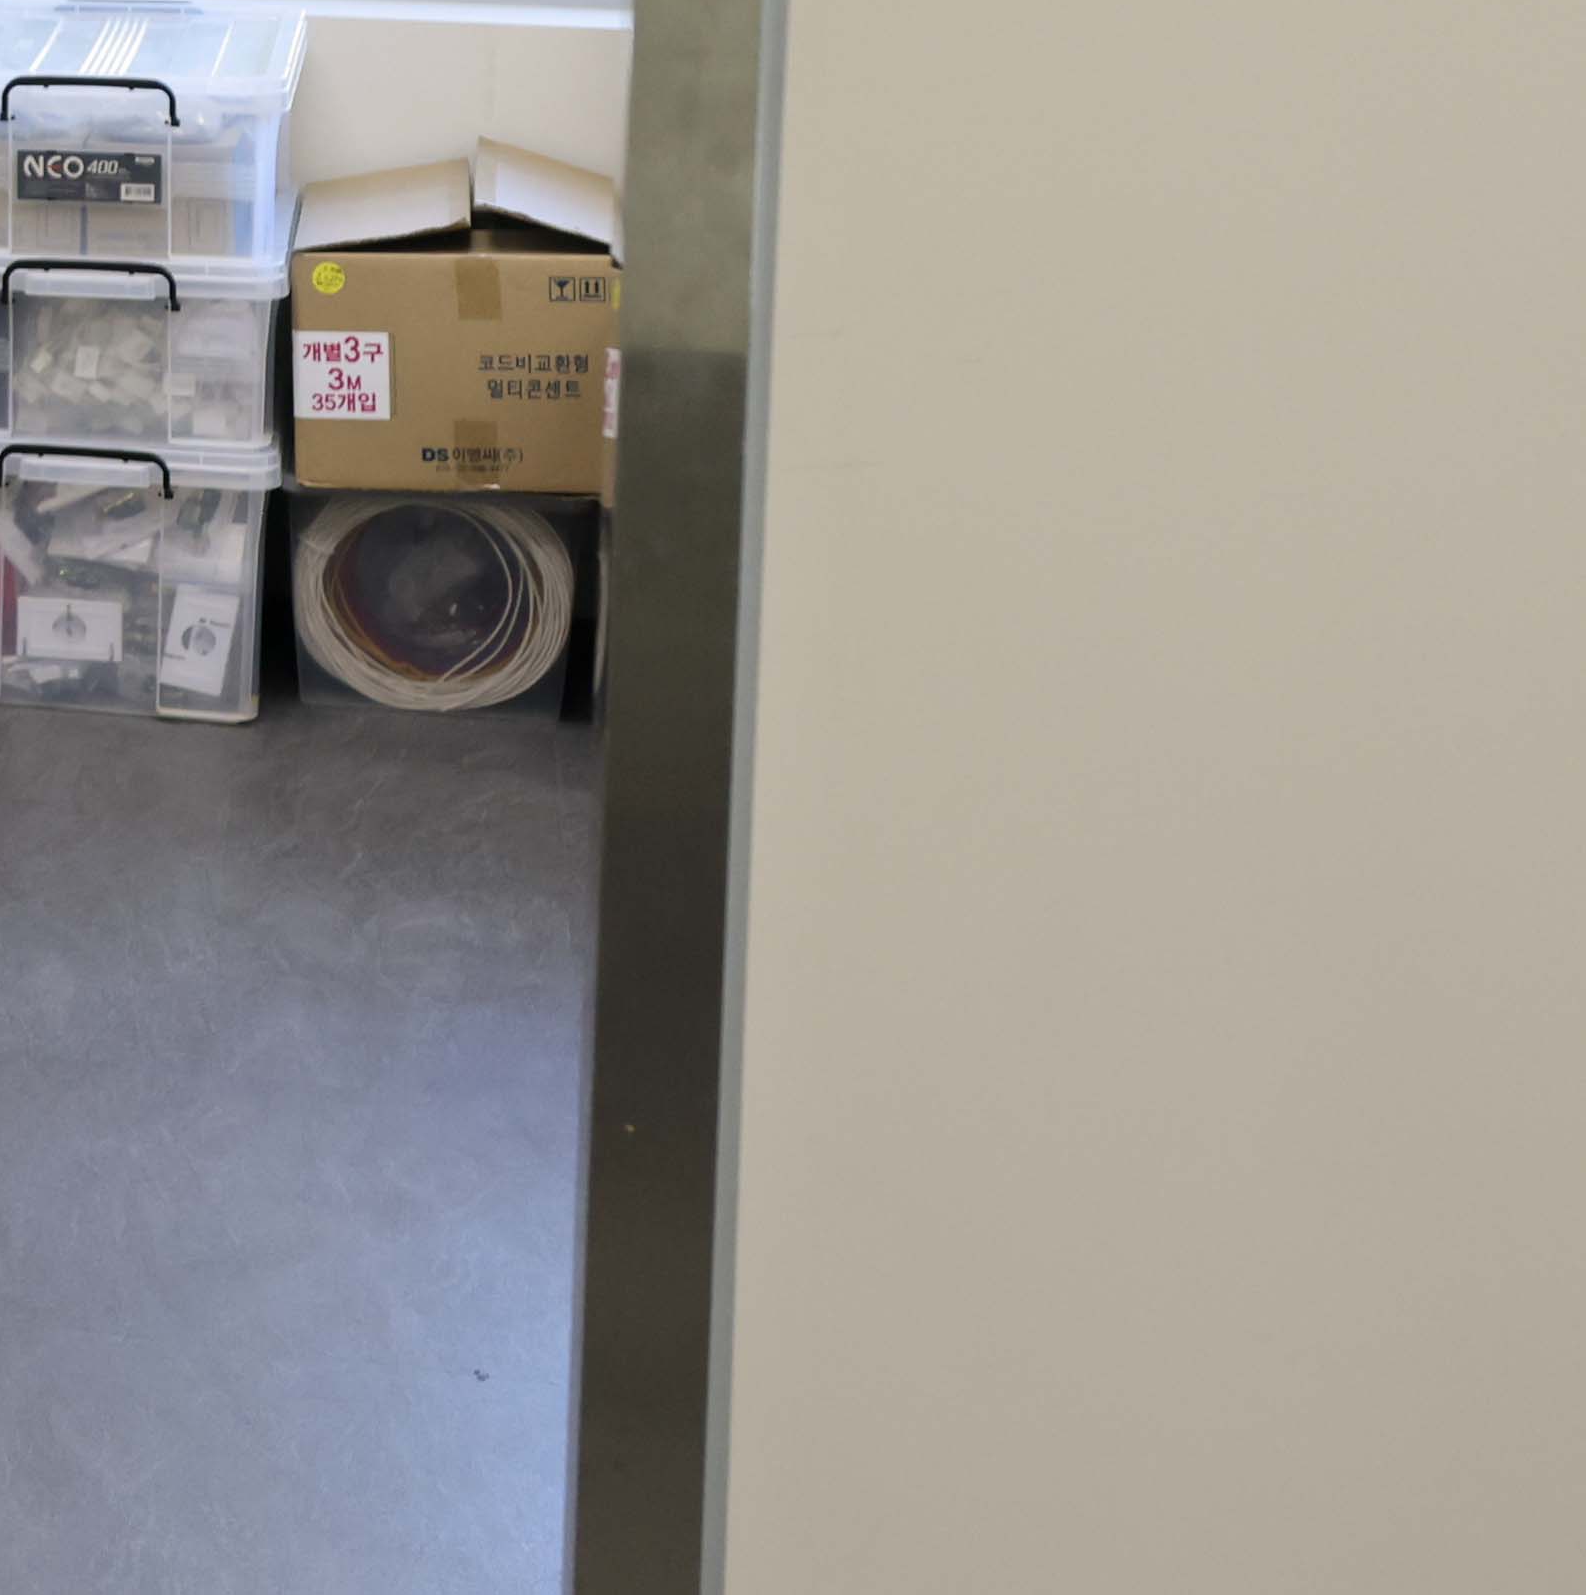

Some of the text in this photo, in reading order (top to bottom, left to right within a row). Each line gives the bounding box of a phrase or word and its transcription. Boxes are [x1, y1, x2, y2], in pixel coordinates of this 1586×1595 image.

[23, 154, 119, 179] NEO 400
[303, 336, 384, 364] 개별3구
[328, 368, 362, 391] 3M
[311, 392, 377, 413] 35개입
[421, 447, 450, 463] DS
